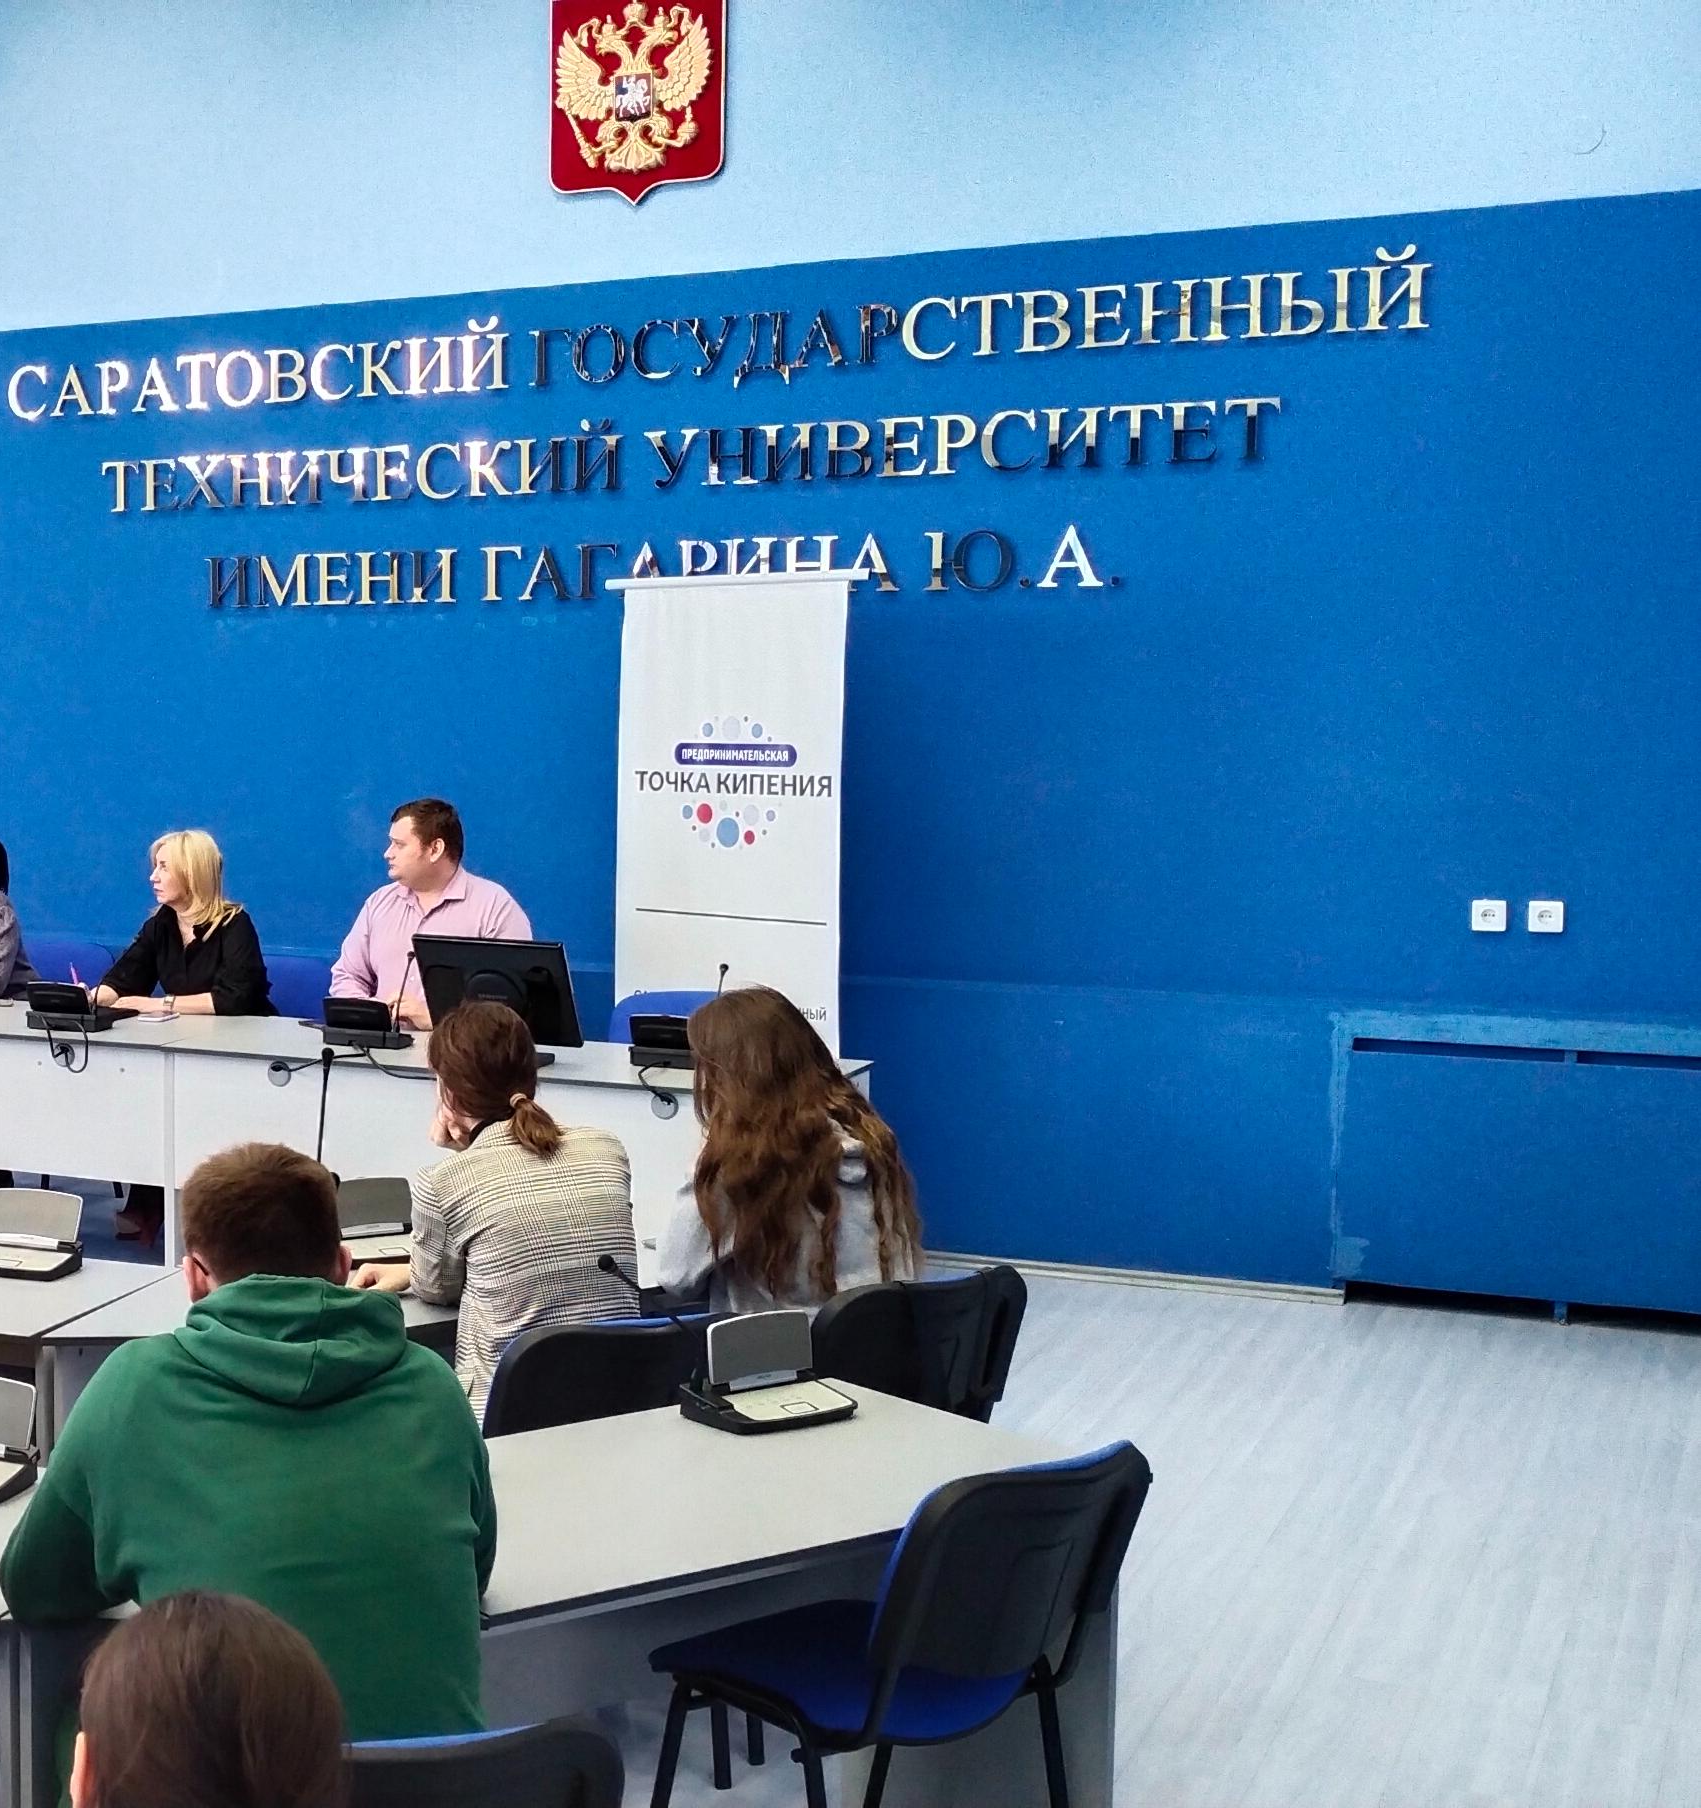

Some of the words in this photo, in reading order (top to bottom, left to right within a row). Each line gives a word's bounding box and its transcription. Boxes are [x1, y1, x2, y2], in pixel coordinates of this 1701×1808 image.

[7, 315, 509, 421] САРАТОВСКИЙ
[528, 243, 1433, 390] ГОСУДАРСТВЕННЫЙ
[101, 417, 623, 513] ТЕХНИЧЕСКИЙ
[643, 395, 1282, 489] УНИВЕРСИТЕТ
[204, 548, 459, 608] ИМЕНИ
[479, 532, 900, 601] ГАГАРИНА
[635, 770, 711, 793] ТОЧКА
[716, 773, 833, 798] КИПЕНИЯ
[681, 748, 789, 762] ПРЕДПРИНИМАТЕЛЬСКАЯ
